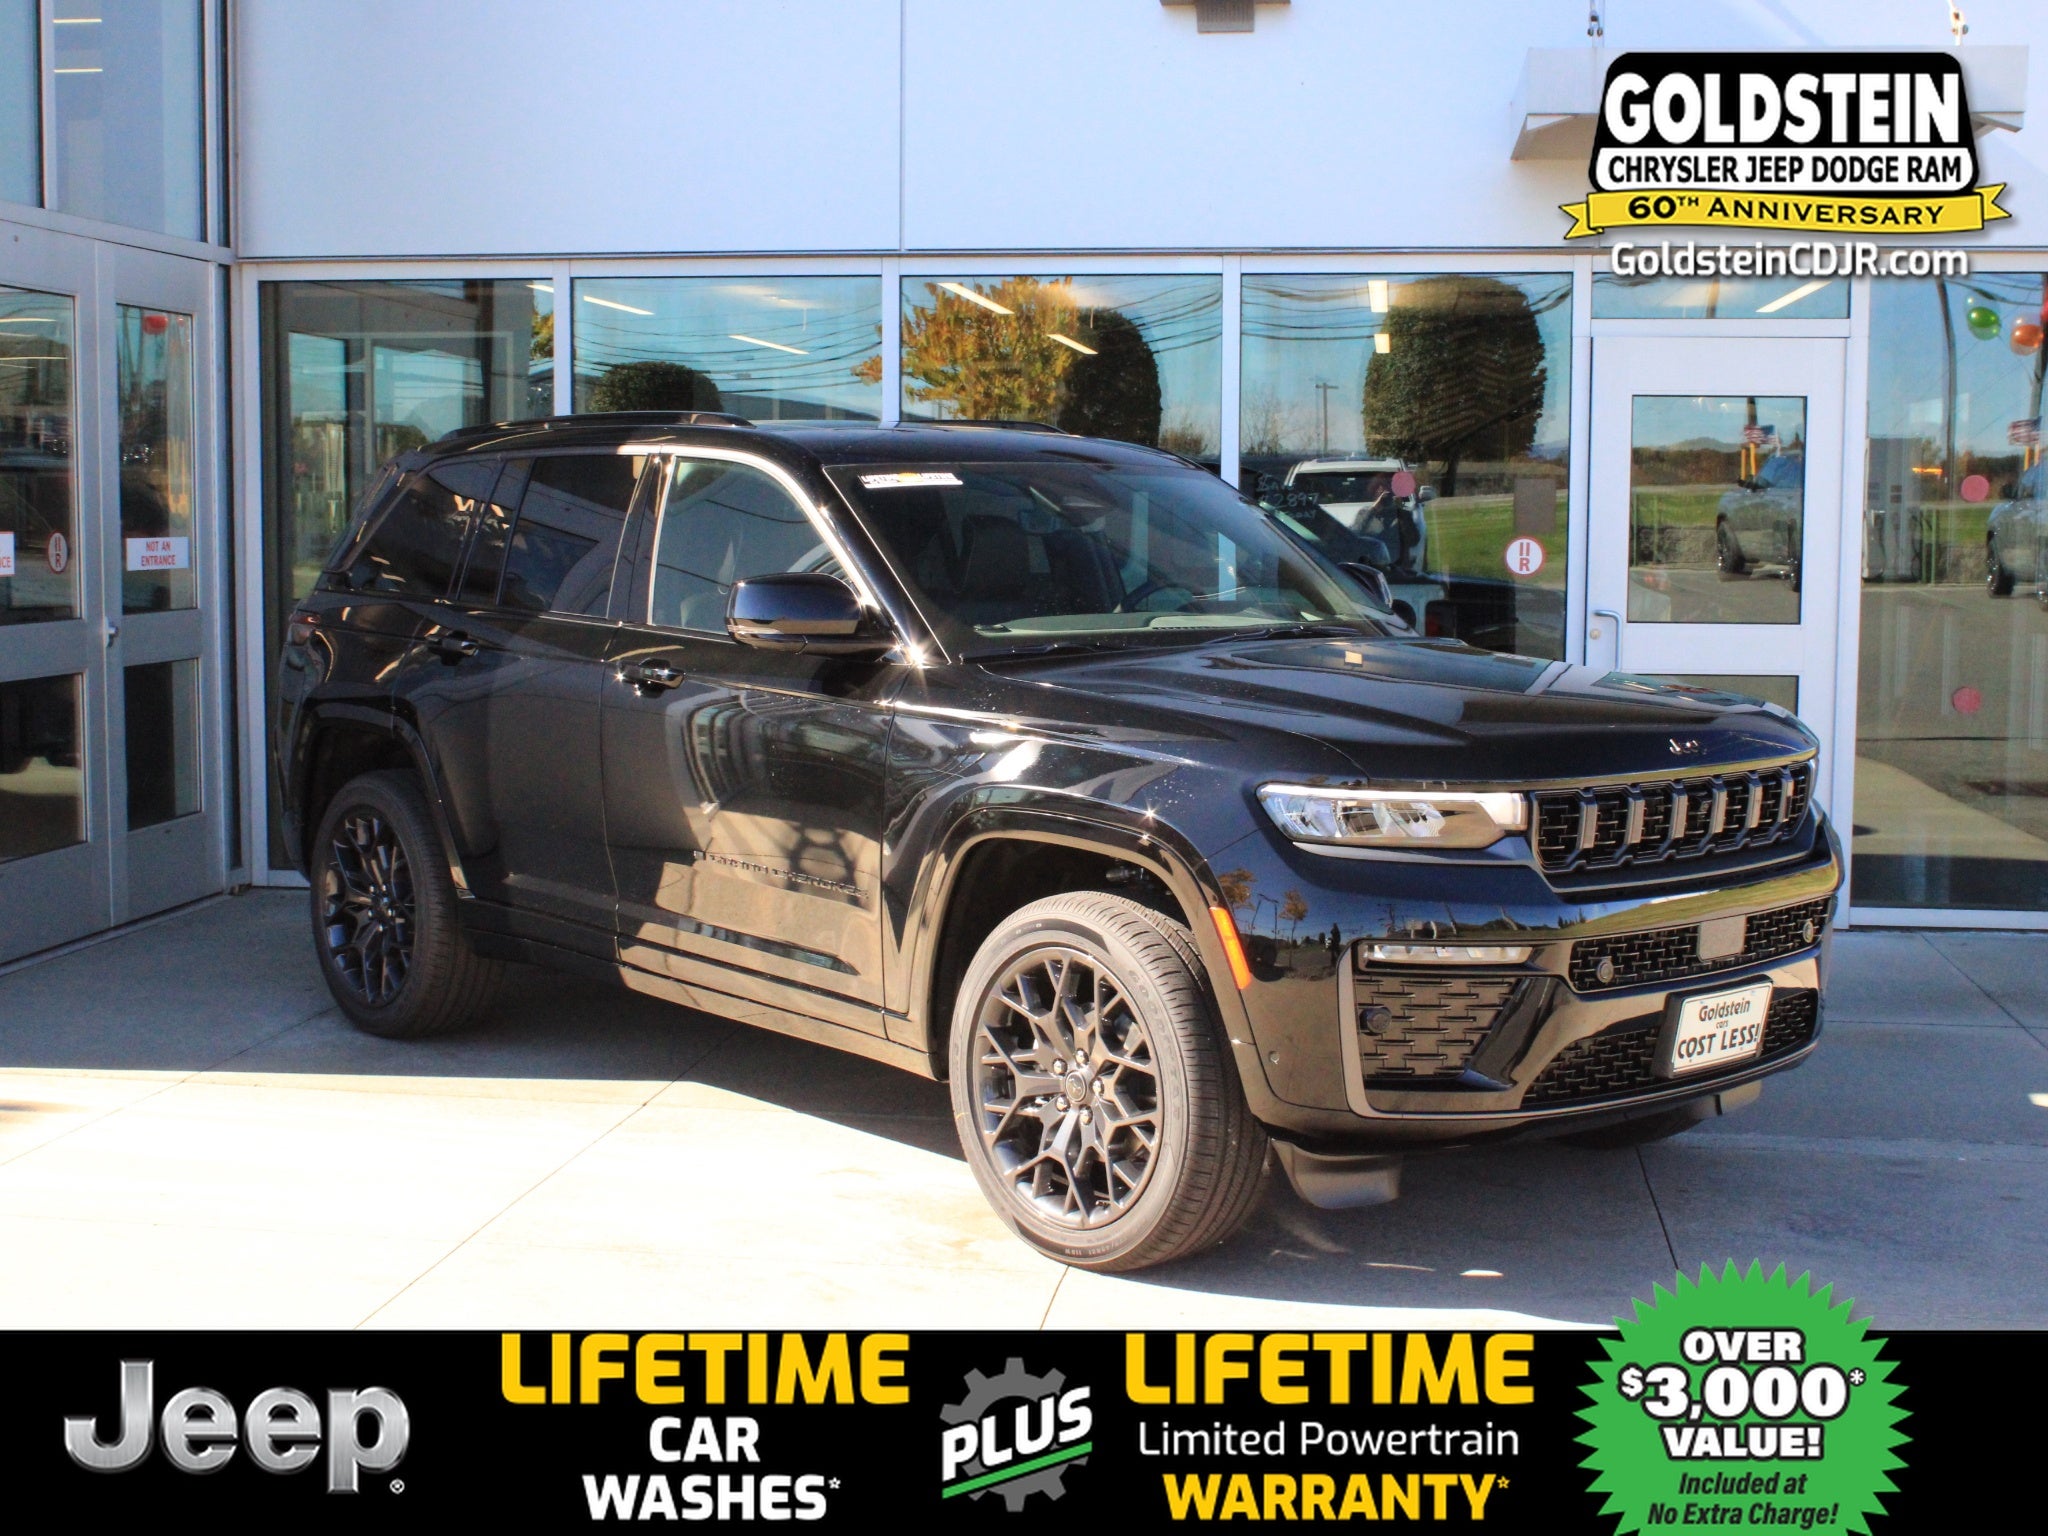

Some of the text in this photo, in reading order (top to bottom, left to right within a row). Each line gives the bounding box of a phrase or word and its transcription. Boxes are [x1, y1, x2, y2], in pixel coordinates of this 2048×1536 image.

[145, 540, 171, 551] NOT AN
[141, 554, 176, 567] ENTRANCE
[1519, 557, 1530, 571] R
[1698, 997, 1751, 1022] Goldstein
[1715, 1019, 1729, 1030] cars
[1677, 1023, 1760, 1059] COST LESS!
